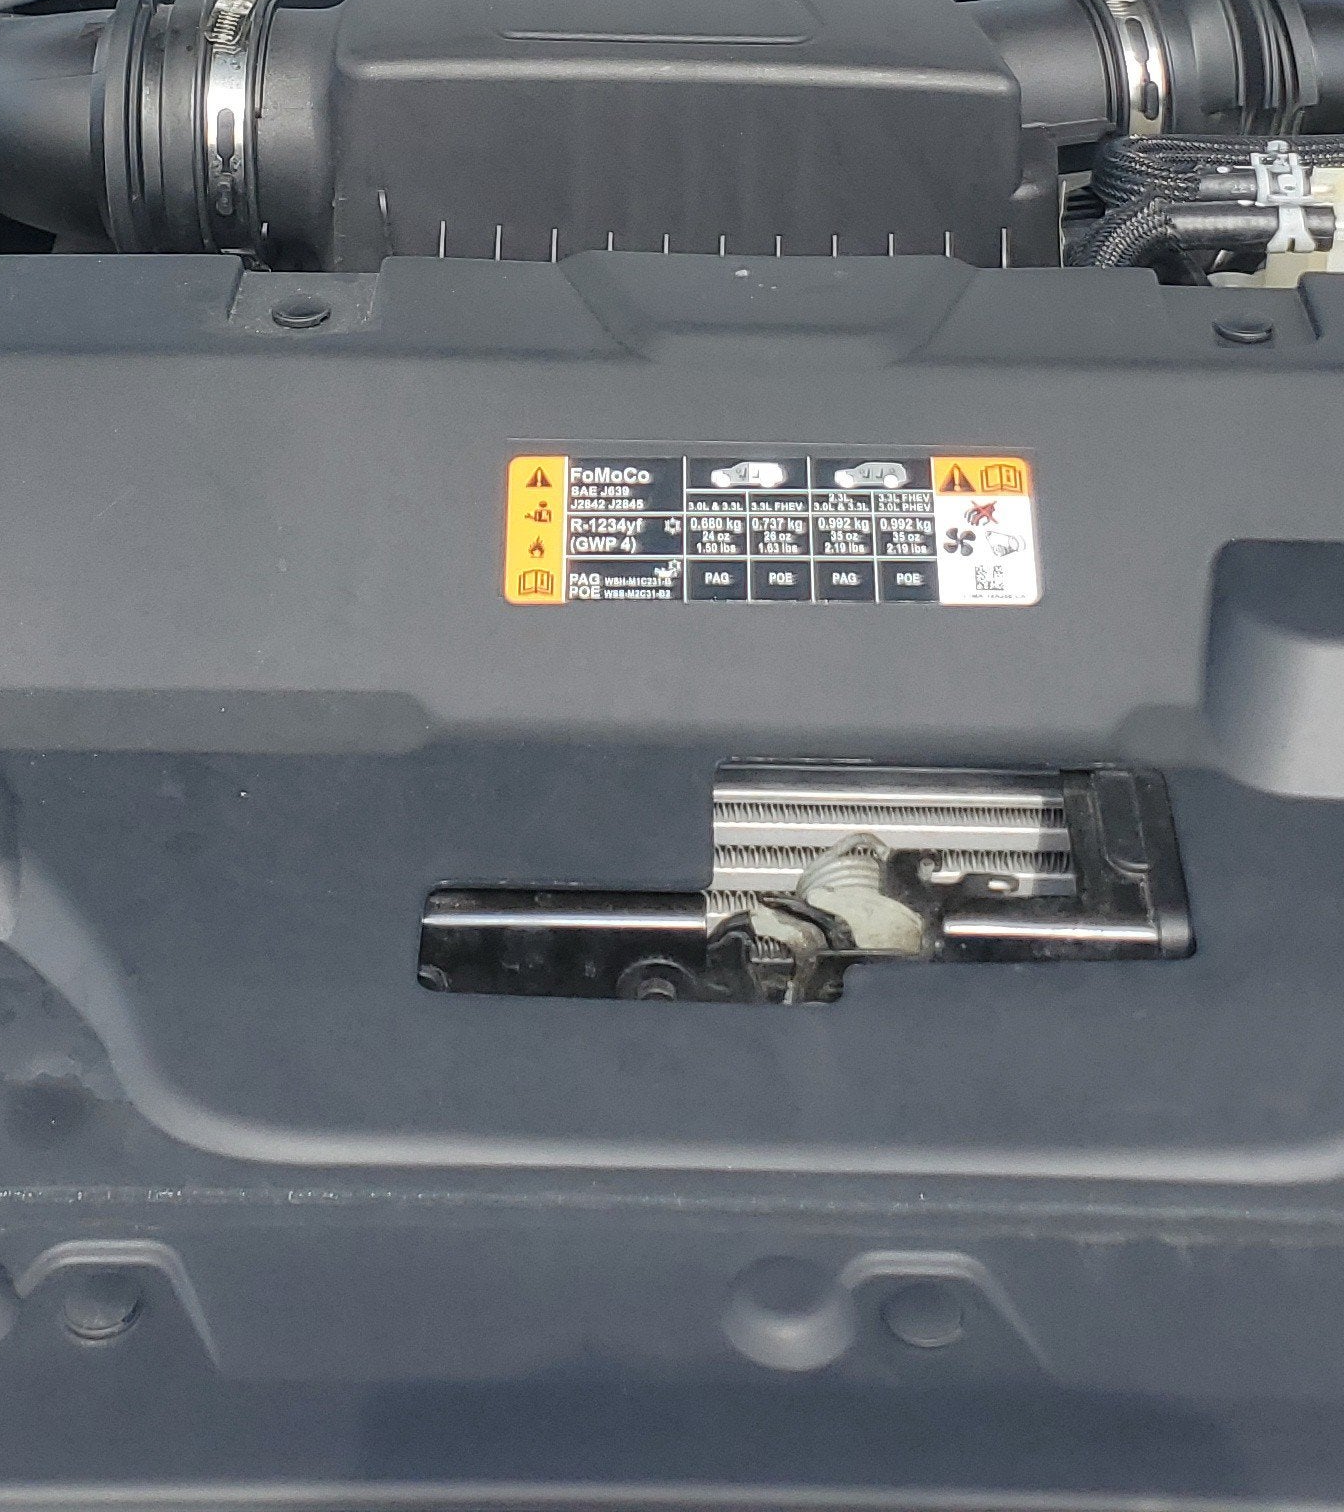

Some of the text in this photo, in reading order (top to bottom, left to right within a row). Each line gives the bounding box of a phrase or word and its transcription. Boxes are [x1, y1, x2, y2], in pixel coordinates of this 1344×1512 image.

[570, 467, 651, 484] FoMoCo
[601, 486, 630, 497] J639
[774, 501, 803, 511] FHEV
[570, 518, 643, 536] R-1234yf
[726, 517, 742, 534] kg
[751, 518, 803, 534] 0.737 kg
[853, 517, 869, 533] kg
[879, 518, 931, 534] 0.992 kg
[702, 531, 730, 541] 24 oz
[778, 533, 792, 541] oz
[830, 531, 859, 541] 35 oz
[892, 532, 921, 542] 35 oz
[570, 536, 637, 554] (GWP 4)
[720, 543, 736, 553] lbs
[782, 543, 798, 553] lbs
[848, 542, 865, 553] lbs
[886, 543, 927, 554] 2.19 lbs
[569, 573, 600, 585] PAG
[704, 572, 730, 584] PAG
[768, 572, 794, 584] POE
[832, 572, 858, 584] PAG
[896, 573, 921, 584] POE
[569, 586, 600, 599] POE
